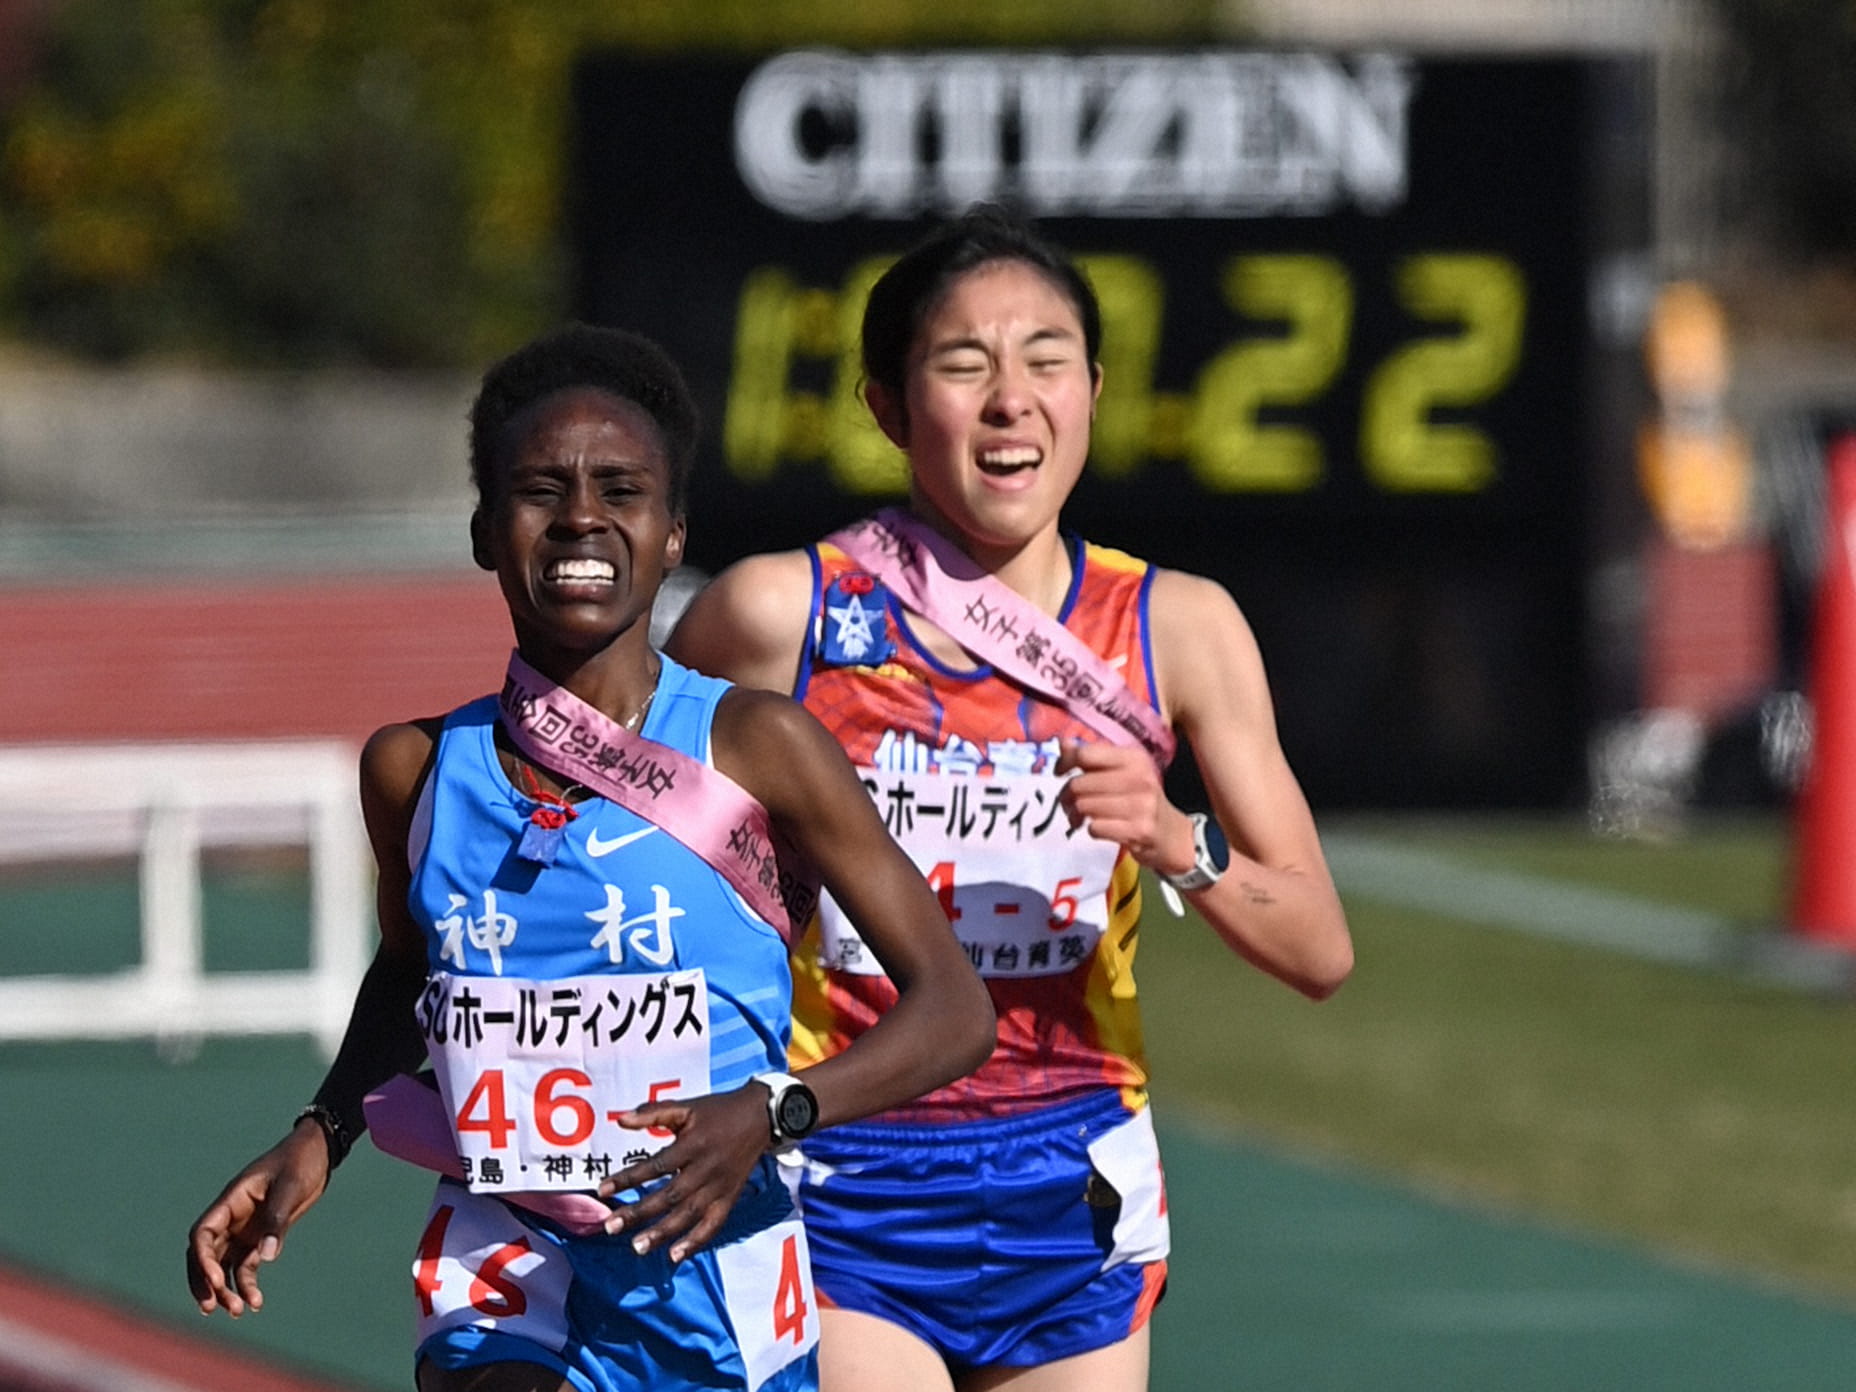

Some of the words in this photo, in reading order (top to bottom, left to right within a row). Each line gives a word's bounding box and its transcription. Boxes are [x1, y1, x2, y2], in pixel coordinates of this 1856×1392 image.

[735, 50, 1412, 219] CITIZEN
[864, 779, 1083, 842] ホールディン
[435, 884, 686, 976] 神村
[774, 1234, 807, 1346] 4
